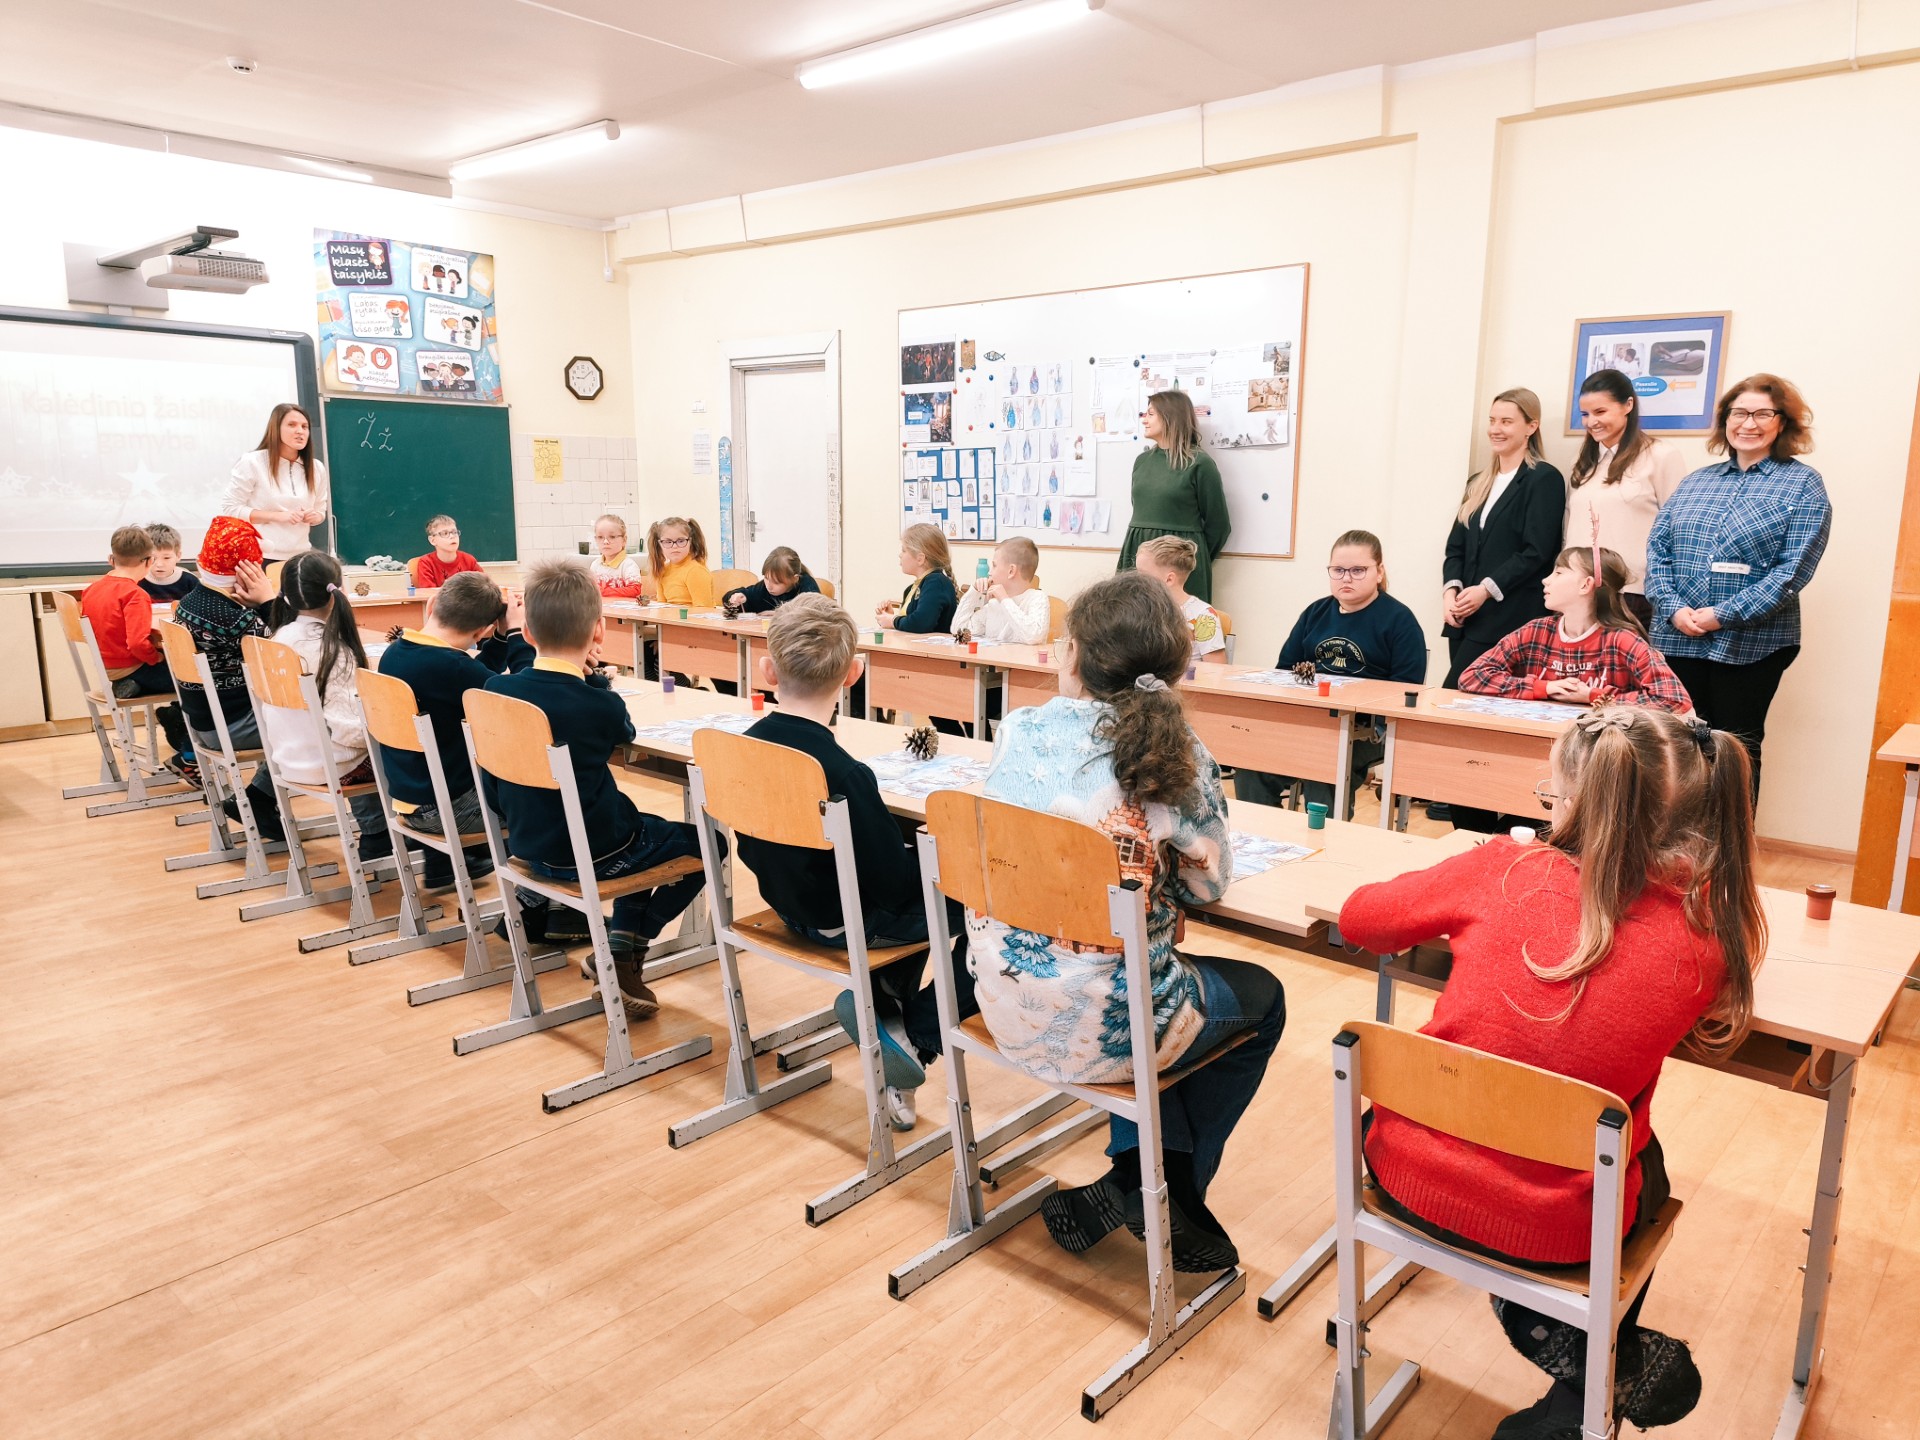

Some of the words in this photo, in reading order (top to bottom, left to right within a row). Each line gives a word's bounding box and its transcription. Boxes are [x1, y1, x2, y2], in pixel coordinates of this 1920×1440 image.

[330, 245, 365, 257] Mūsų
[332, 257, 369, 267] klasės
[334, 268, 388, 284] taisyklės
[21, 390, 147, 418] Kalėdinio
[97, 429, 198, 455] gamyba
[1566, 661, 1593, 672] CLUB
